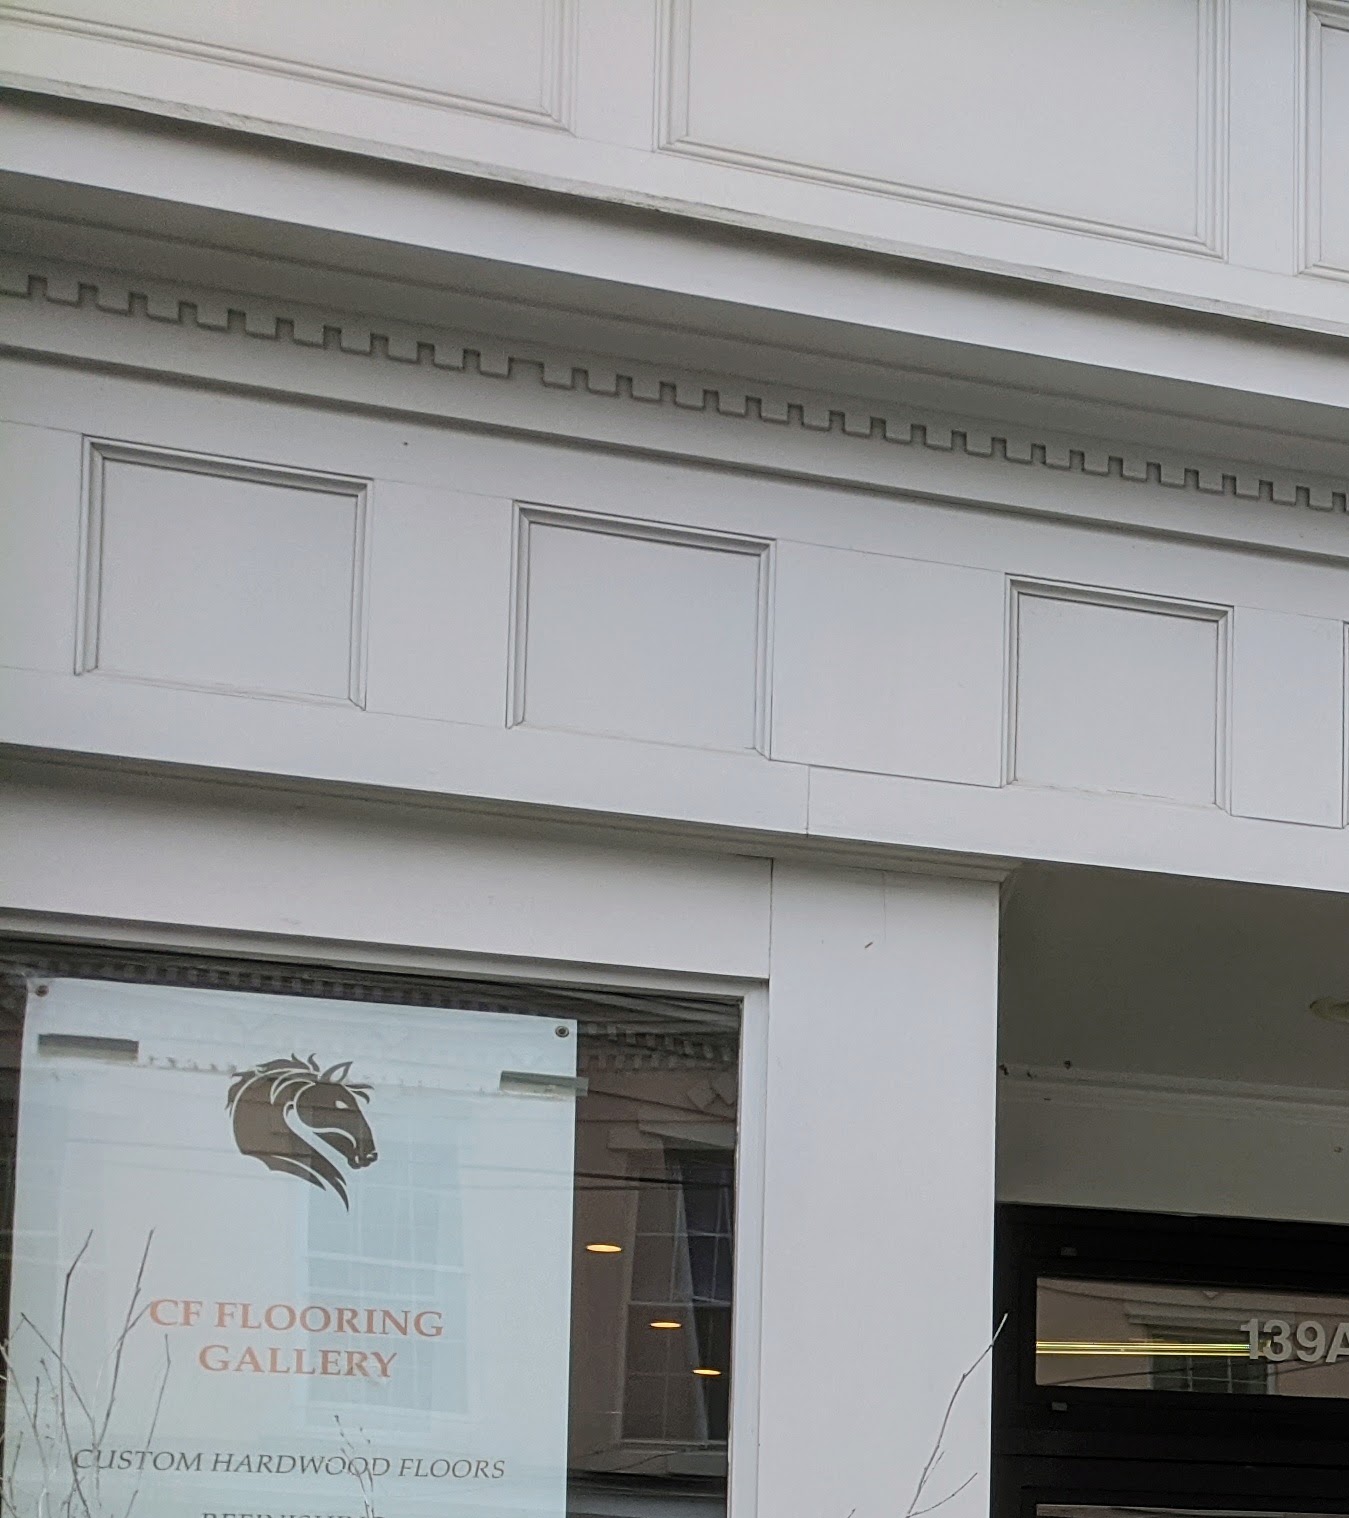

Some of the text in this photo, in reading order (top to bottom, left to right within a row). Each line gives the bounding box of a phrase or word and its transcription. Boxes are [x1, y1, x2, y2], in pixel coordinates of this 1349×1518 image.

[149, 1298, 444, 1338] CF FLOORING
[198, 1344, 397, 1379] GALLERY
[73, 1448, 506, 1479] CUSTOM HARDWOOD FLOORS
